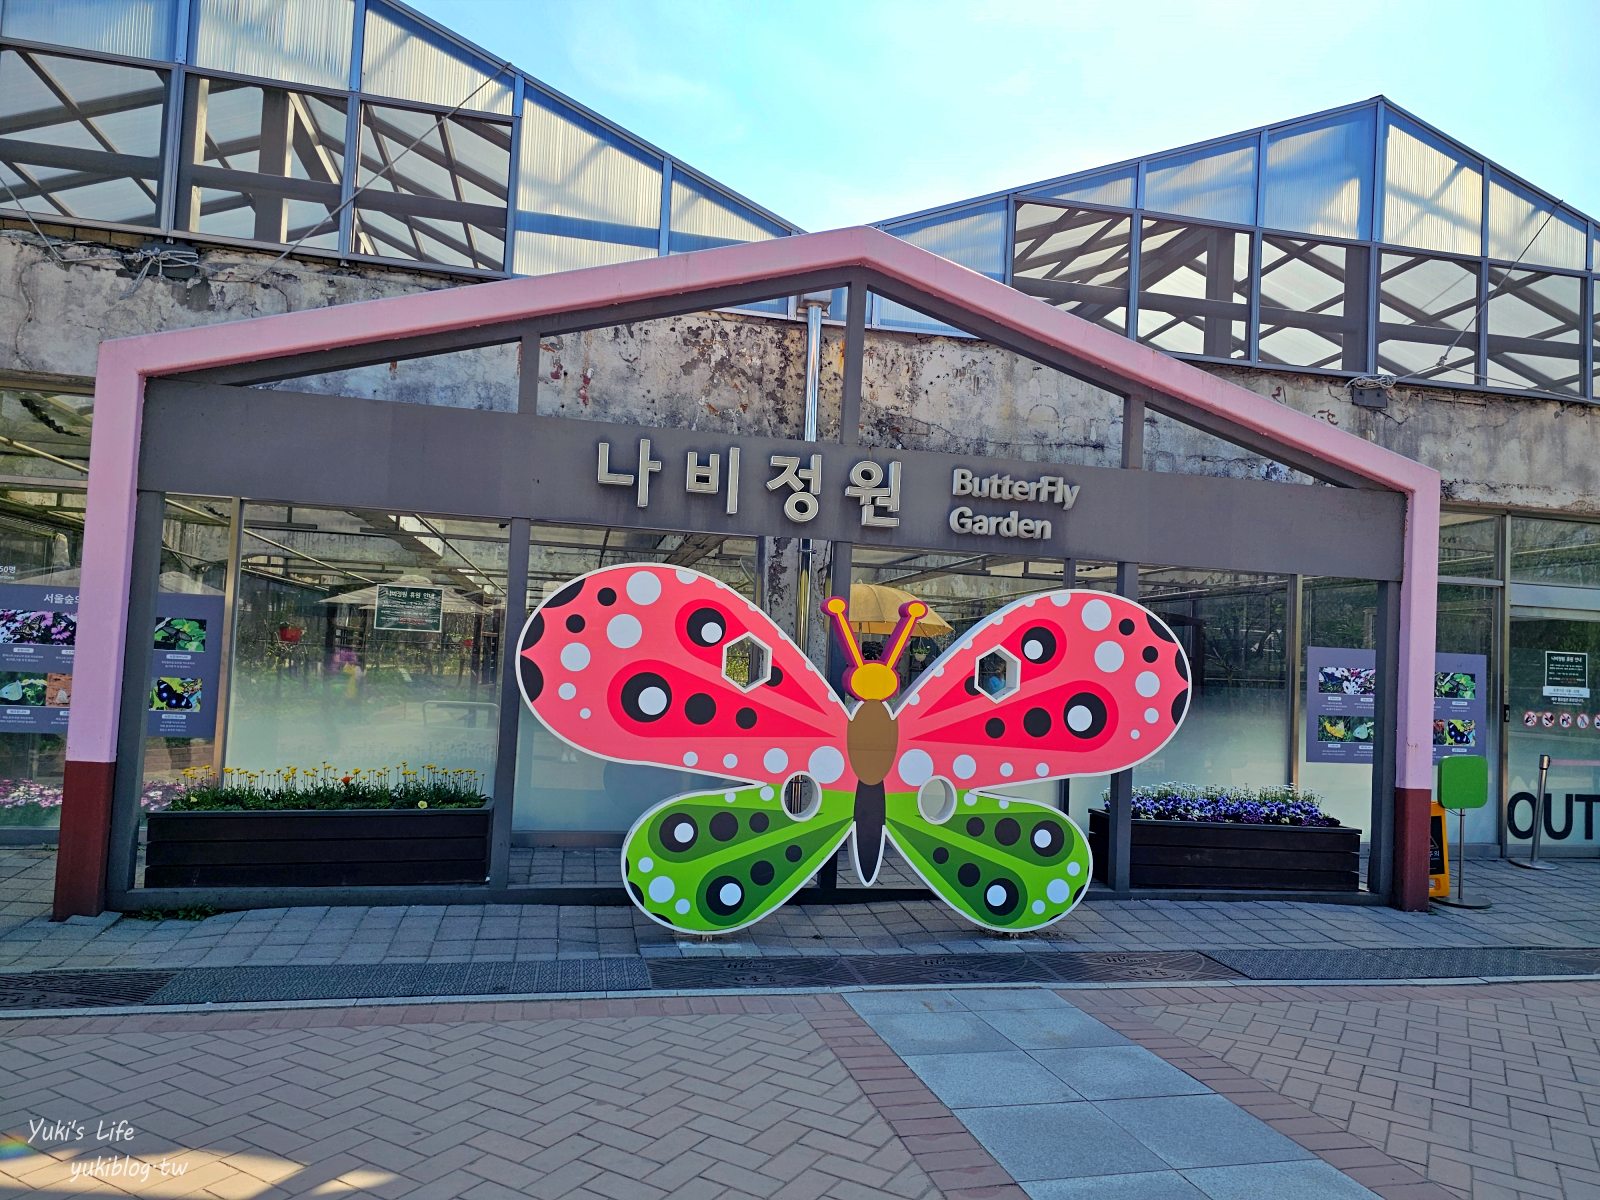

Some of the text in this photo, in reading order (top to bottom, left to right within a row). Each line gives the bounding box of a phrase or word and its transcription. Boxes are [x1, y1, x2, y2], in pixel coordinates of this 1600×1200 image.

[598, 438, 901, 527] 나비정원
[952, 468, 1080, 510] ButterFly
[949, 506, 1052, 539] Garden
[1507, 791, 1600, 840] OUT
